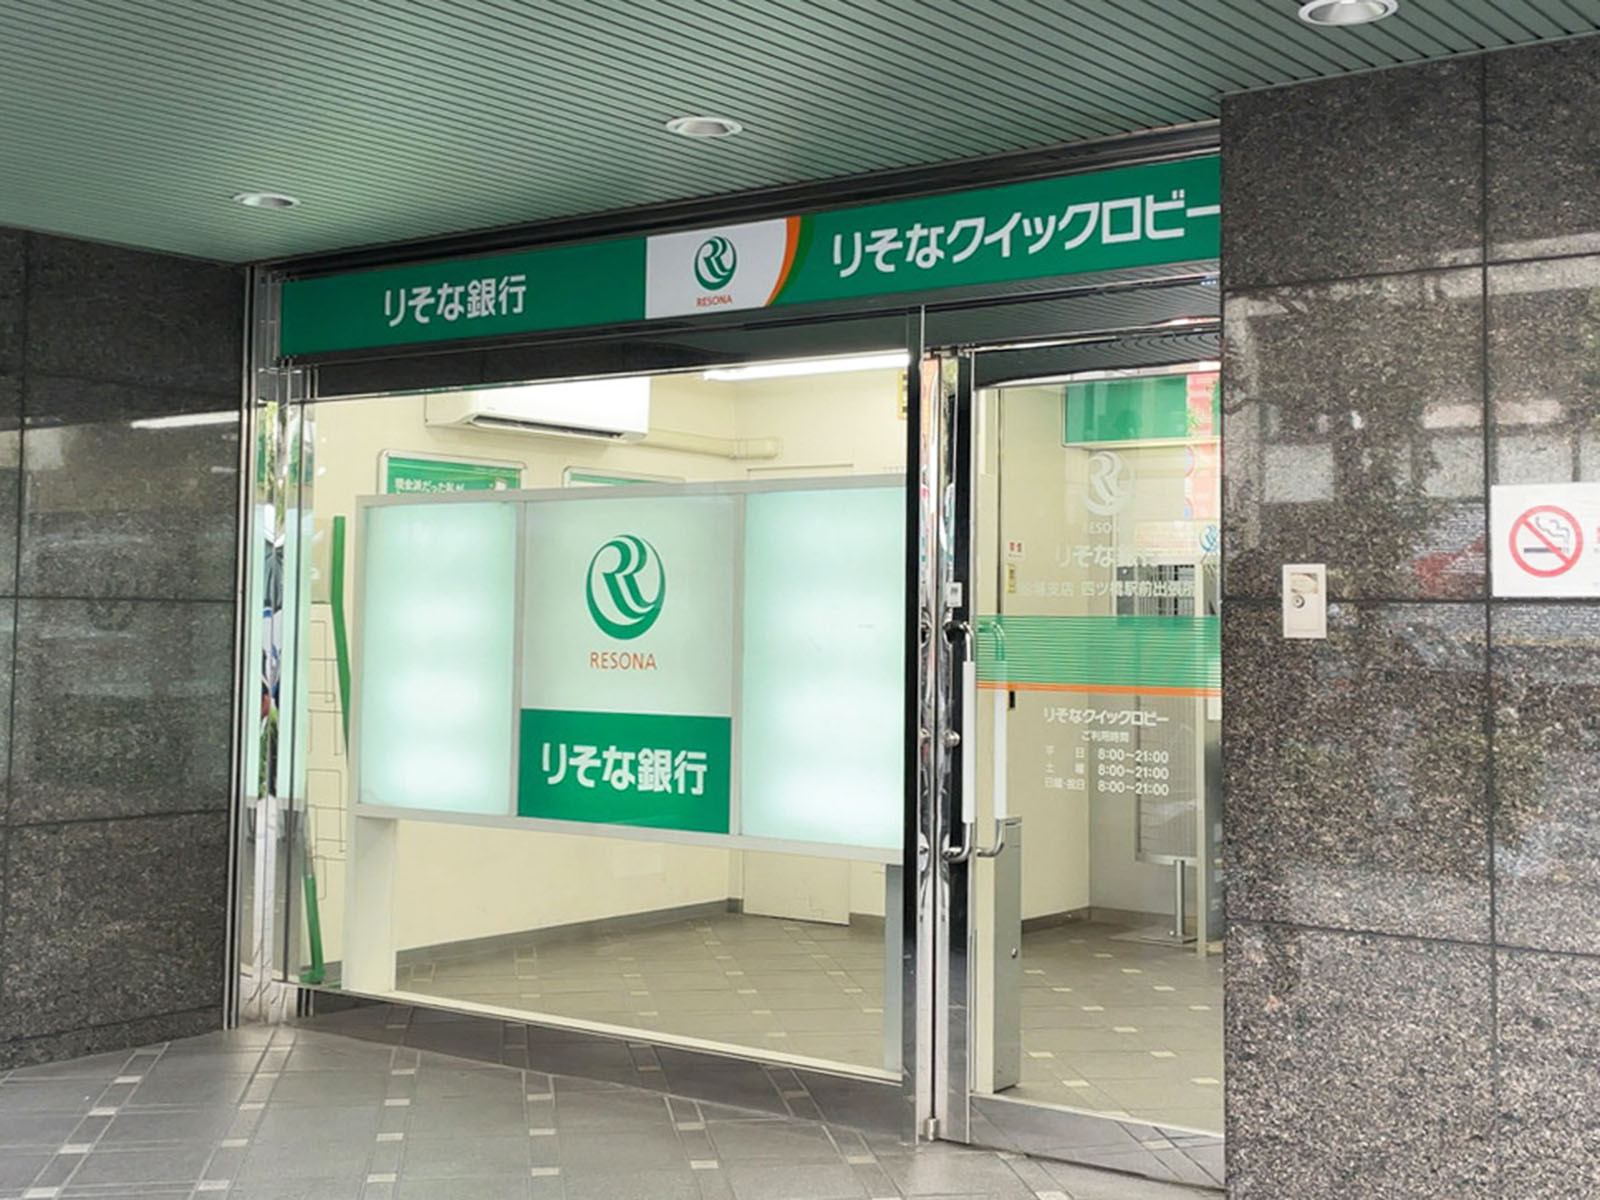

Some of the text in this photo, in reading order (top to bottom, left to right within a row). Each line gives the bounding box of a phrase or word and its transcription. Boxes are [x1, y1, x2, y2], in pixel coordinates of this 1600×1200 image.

[833, 189, 1220, 278] りそなクイックロビー
[384, 274, 526, 327] りそな銀行
[696, 295, 732, 307] RESONA
[590, 652, 657, 670] RESONA
[1043, 707, 1169, 727] りそなクイックロビー
[542, 742, 707, 796] りそな銀行
